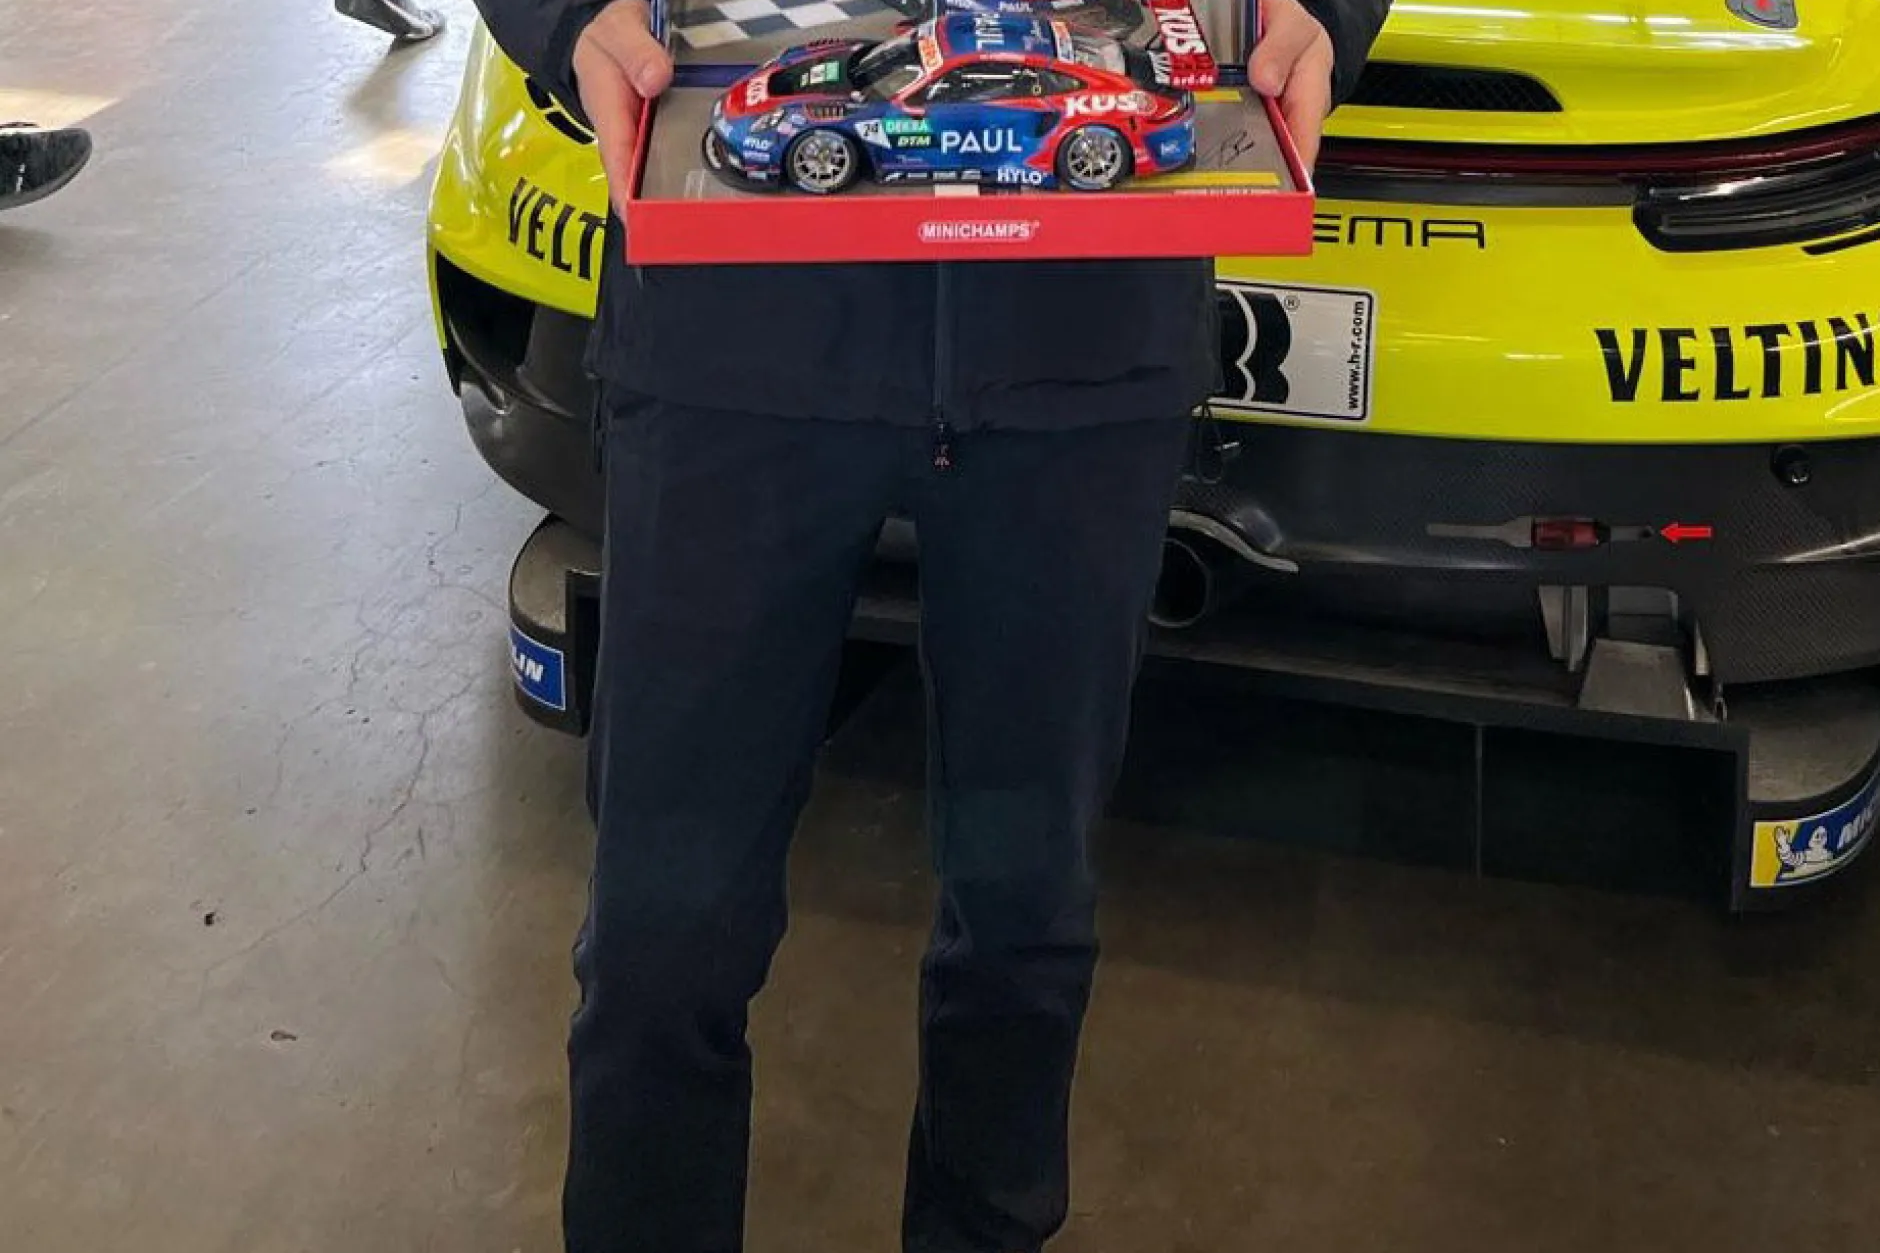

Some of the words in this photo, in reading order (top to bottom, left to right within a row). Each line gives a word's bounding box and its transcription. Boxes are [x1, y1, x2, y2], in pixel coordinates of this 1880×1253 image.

[898, 135, 931, 147] DTM
[941, 128, 1023, 154] PAUL
[997, 168, 1043, 185] HYLO
[508, 176, 606, 282] VELT
[923, 222, 1030, 238] MINICHAMPS
[1347, 300, 1365, 411] www.h-r.com
[1594, 312, 1875, 403] VELTIN
